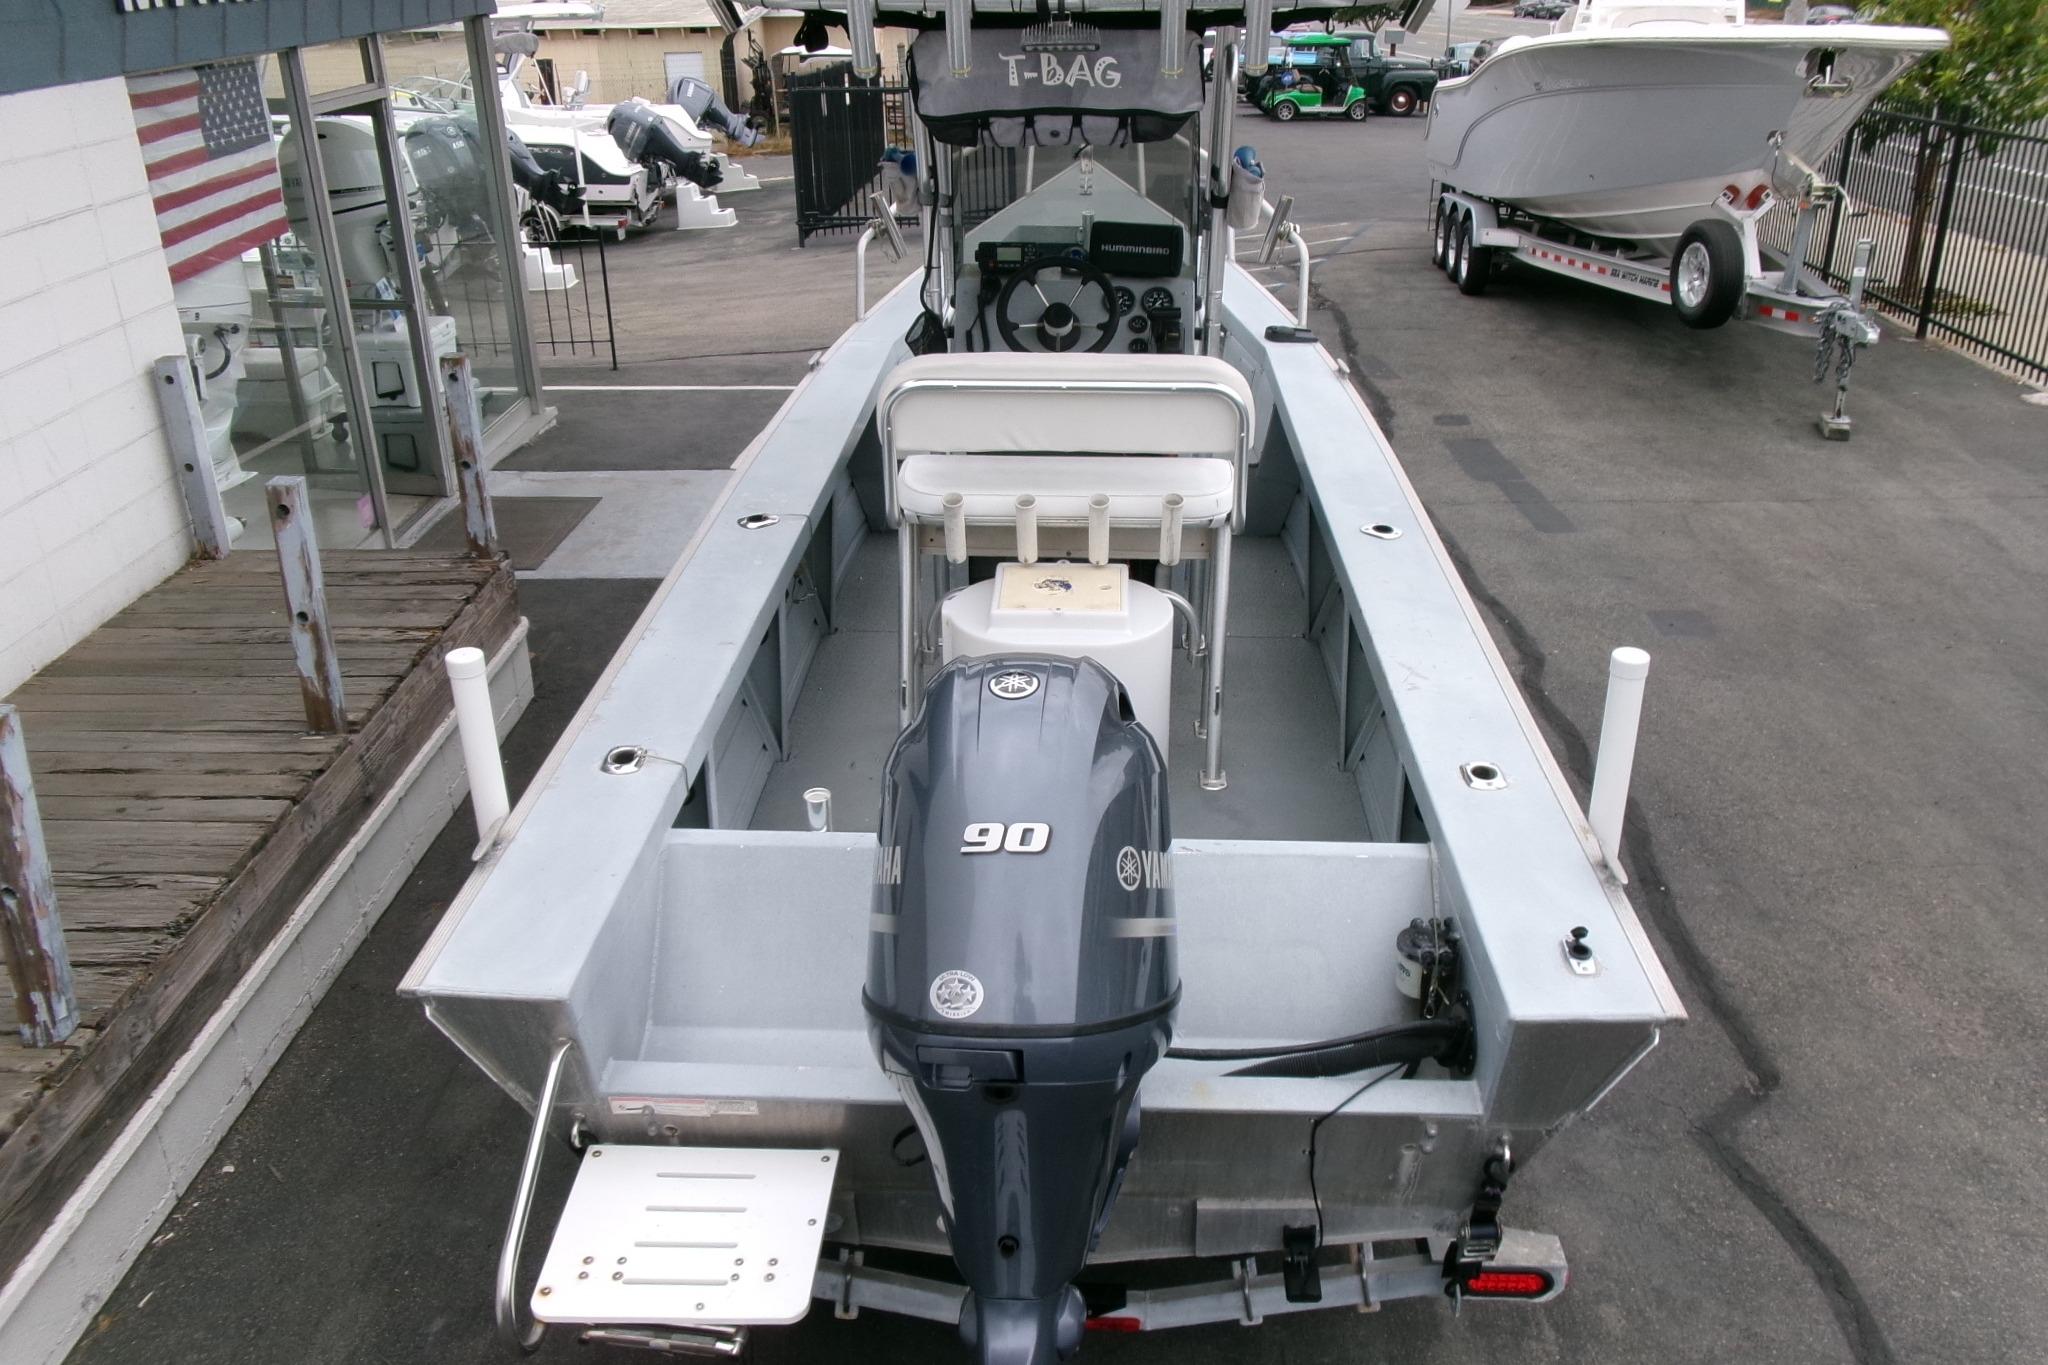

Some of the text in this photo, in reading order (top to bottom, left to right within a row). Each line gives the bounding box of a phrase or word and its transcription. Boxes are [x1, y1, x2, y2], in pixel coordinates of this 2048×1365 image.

[998, 52, 1122, 88] T-BAG
[1101, 243, 1170, 255] HUMMINBIRD
[960, 822, 1050, 853] 90
